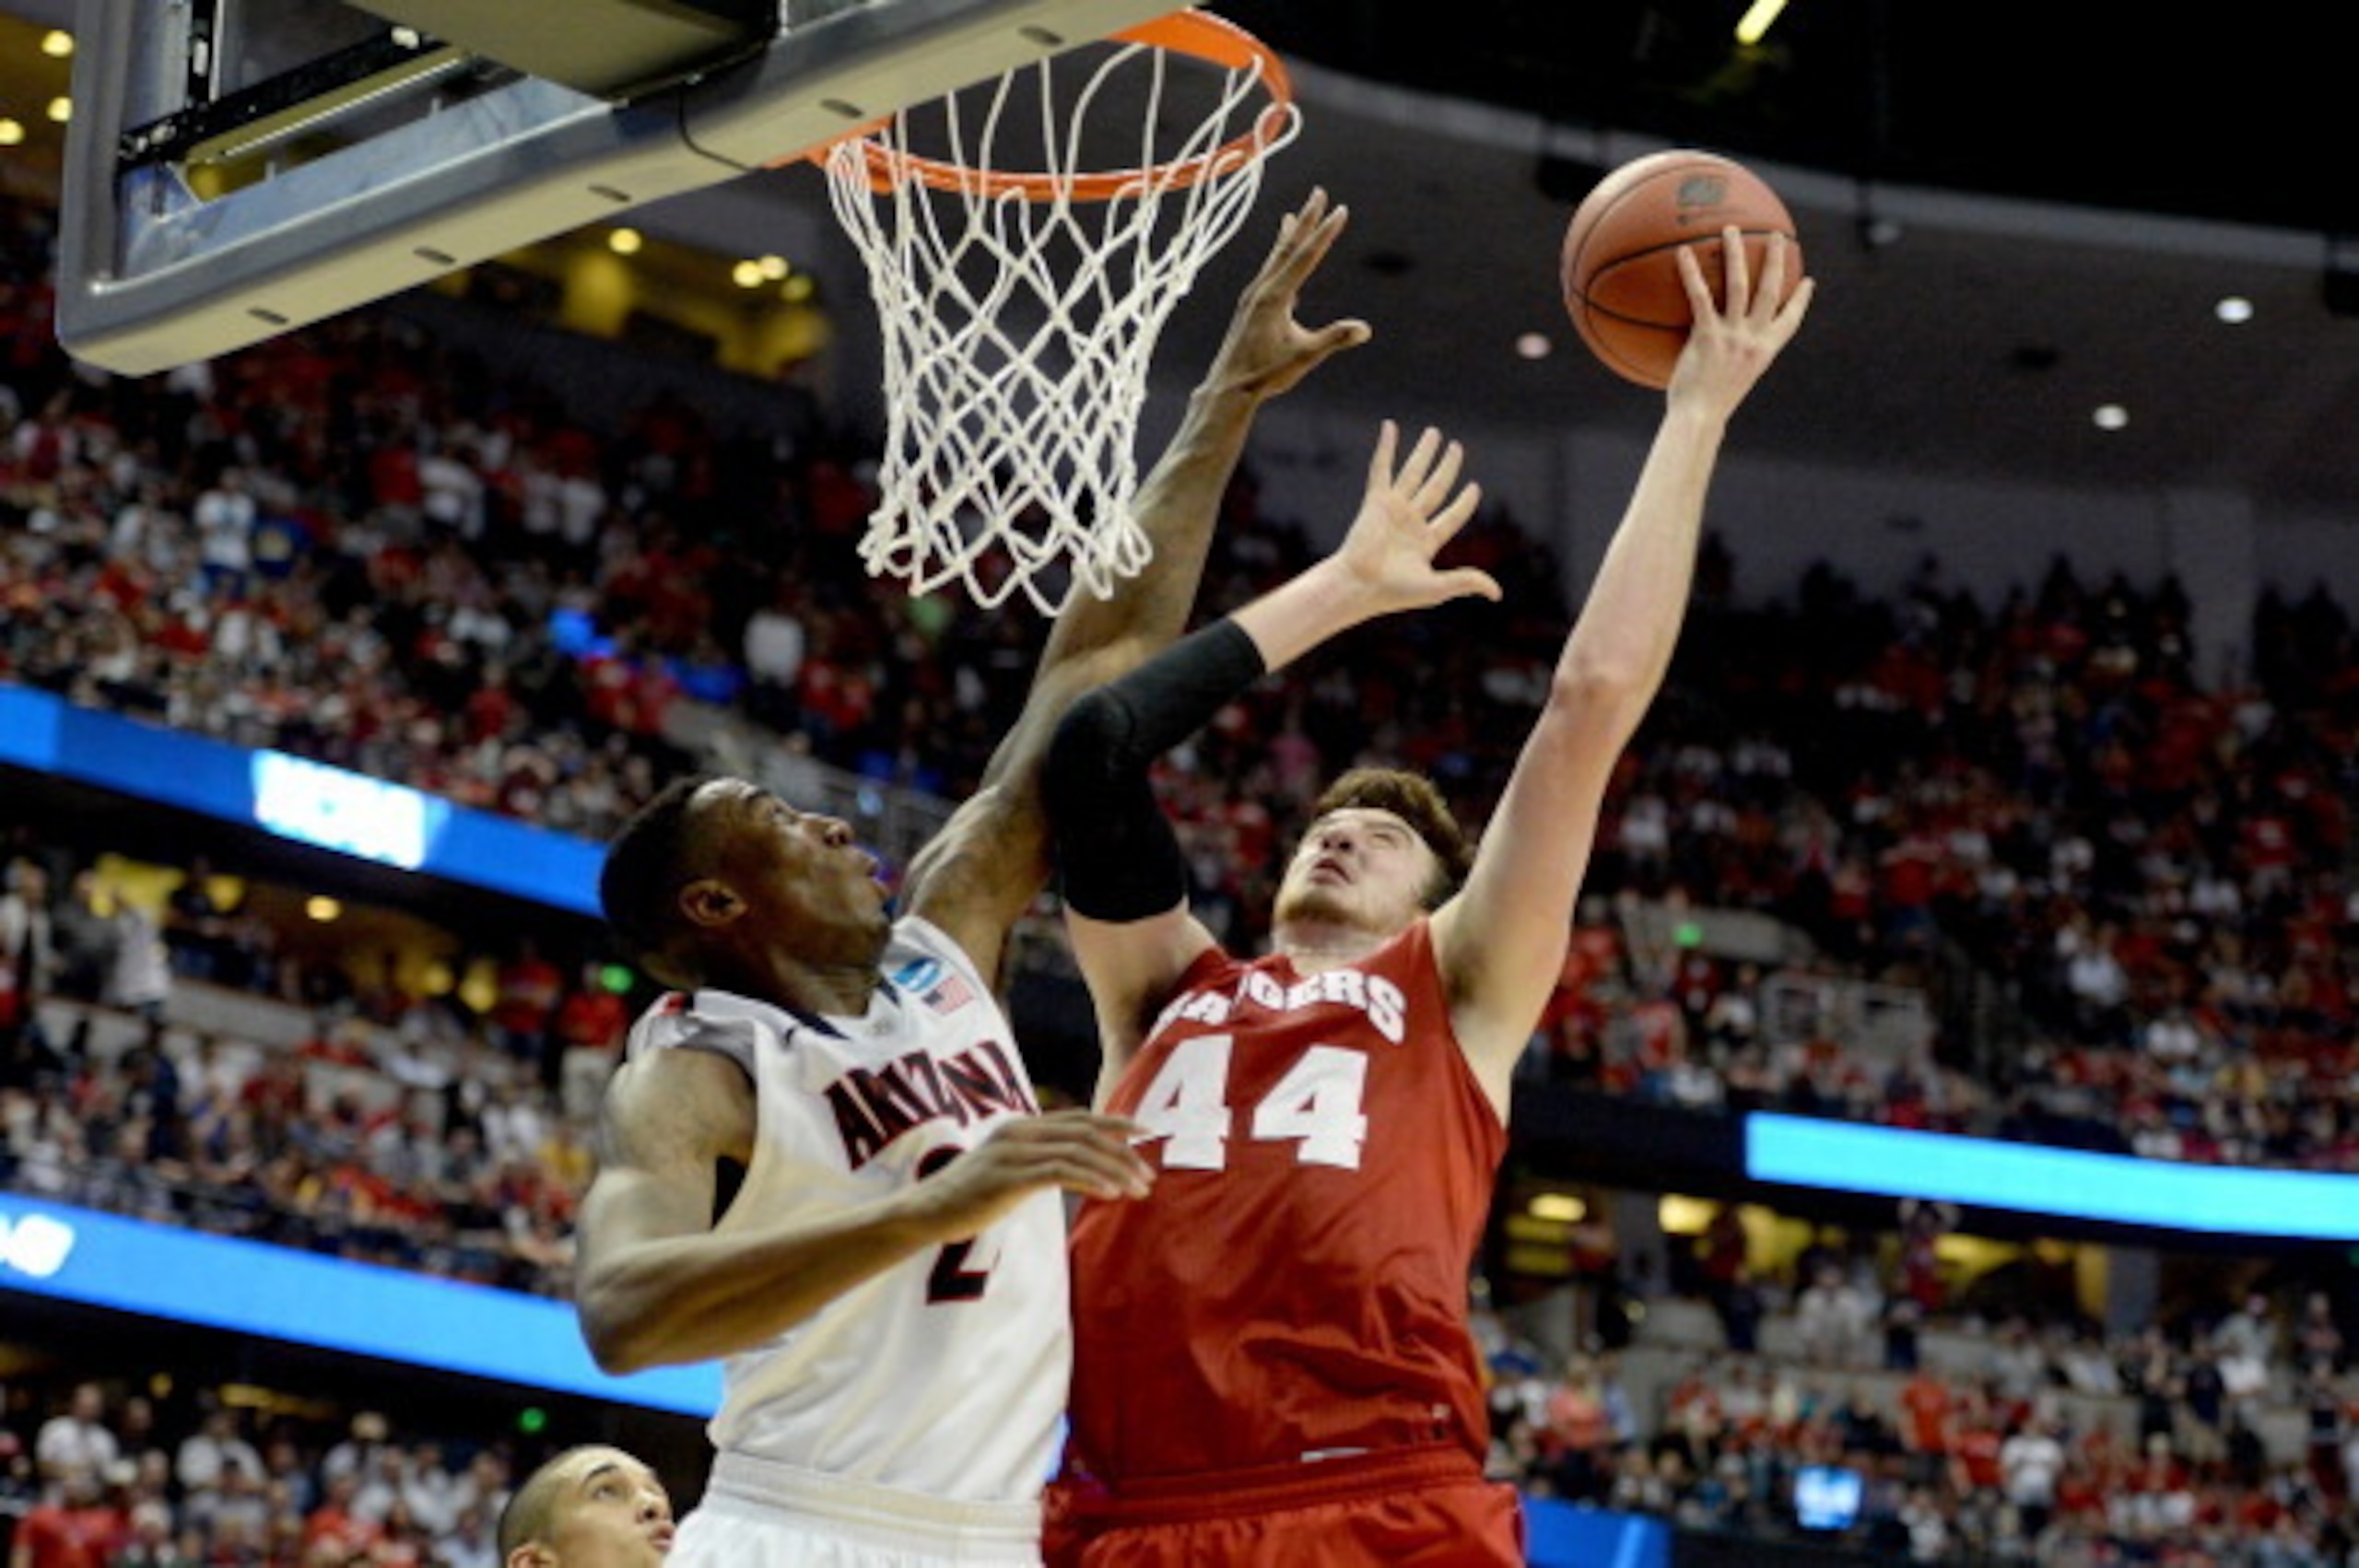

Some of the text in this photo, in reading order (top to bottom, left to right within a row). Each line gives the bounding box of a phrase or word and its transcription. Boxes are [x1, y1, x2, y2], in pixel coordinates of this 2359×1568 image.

[1144, 968, 1407, 1046] AGERS
[824, 1039, 1039, 1173] ARIZNA
[1128, 1035, 1368, 1170] 44
